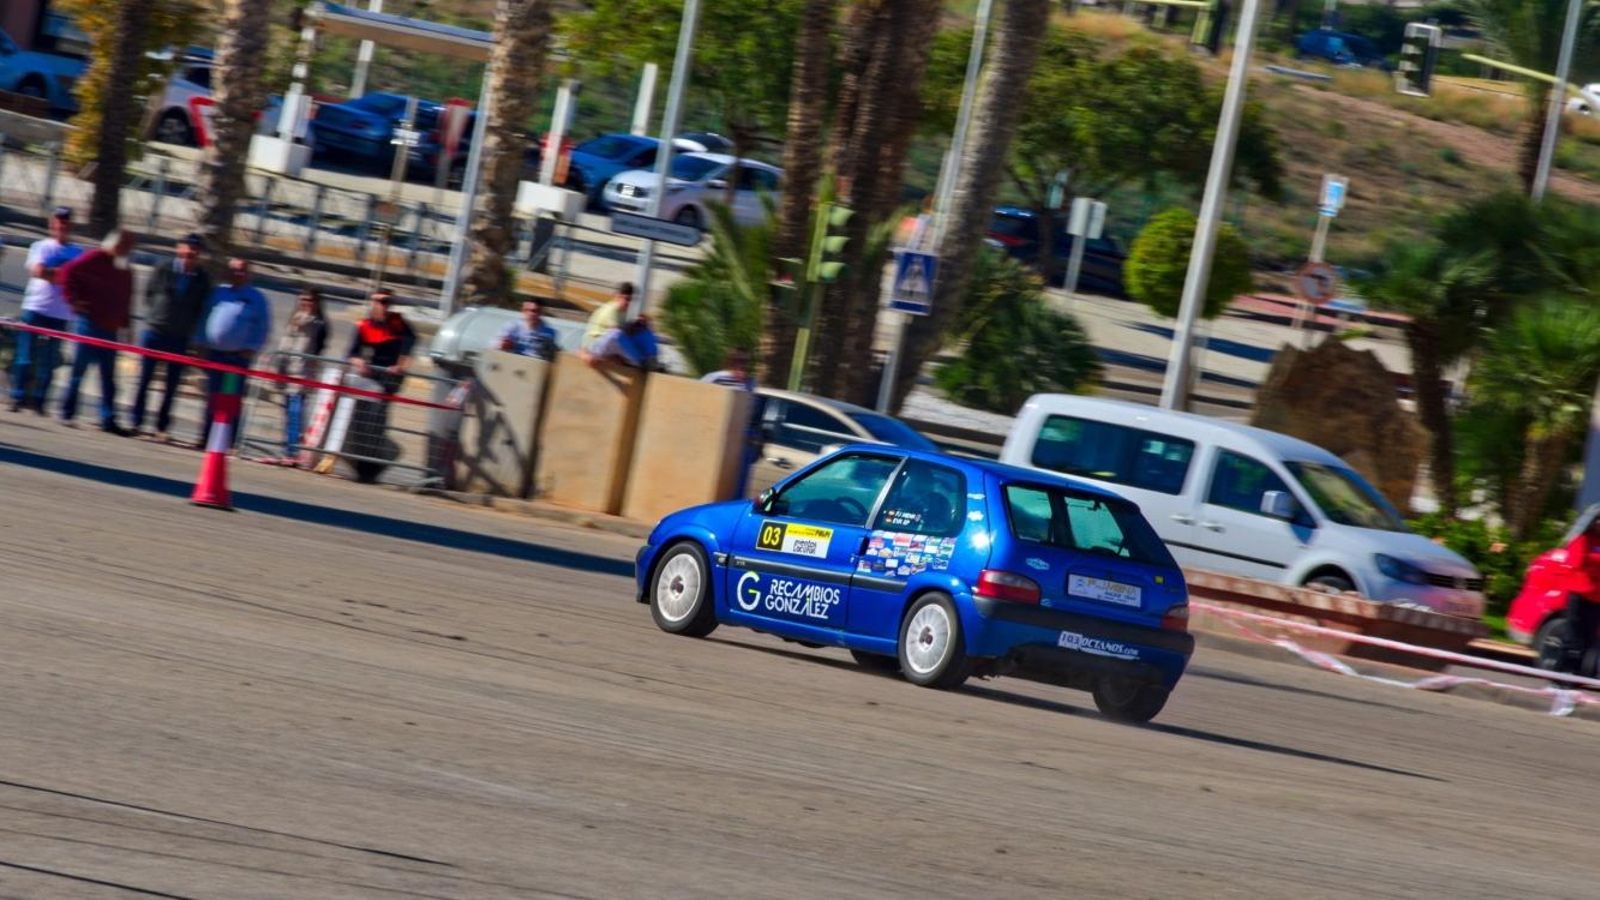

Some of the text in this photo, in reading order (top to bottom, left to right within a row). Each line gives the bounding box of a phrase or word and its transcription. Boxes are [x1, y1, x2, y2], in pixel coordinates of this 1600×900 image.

[763, 525, 781, 546] 03
[736, 570, 761, 611] G
[770, 579, 841, 605] RECAMBIOS
